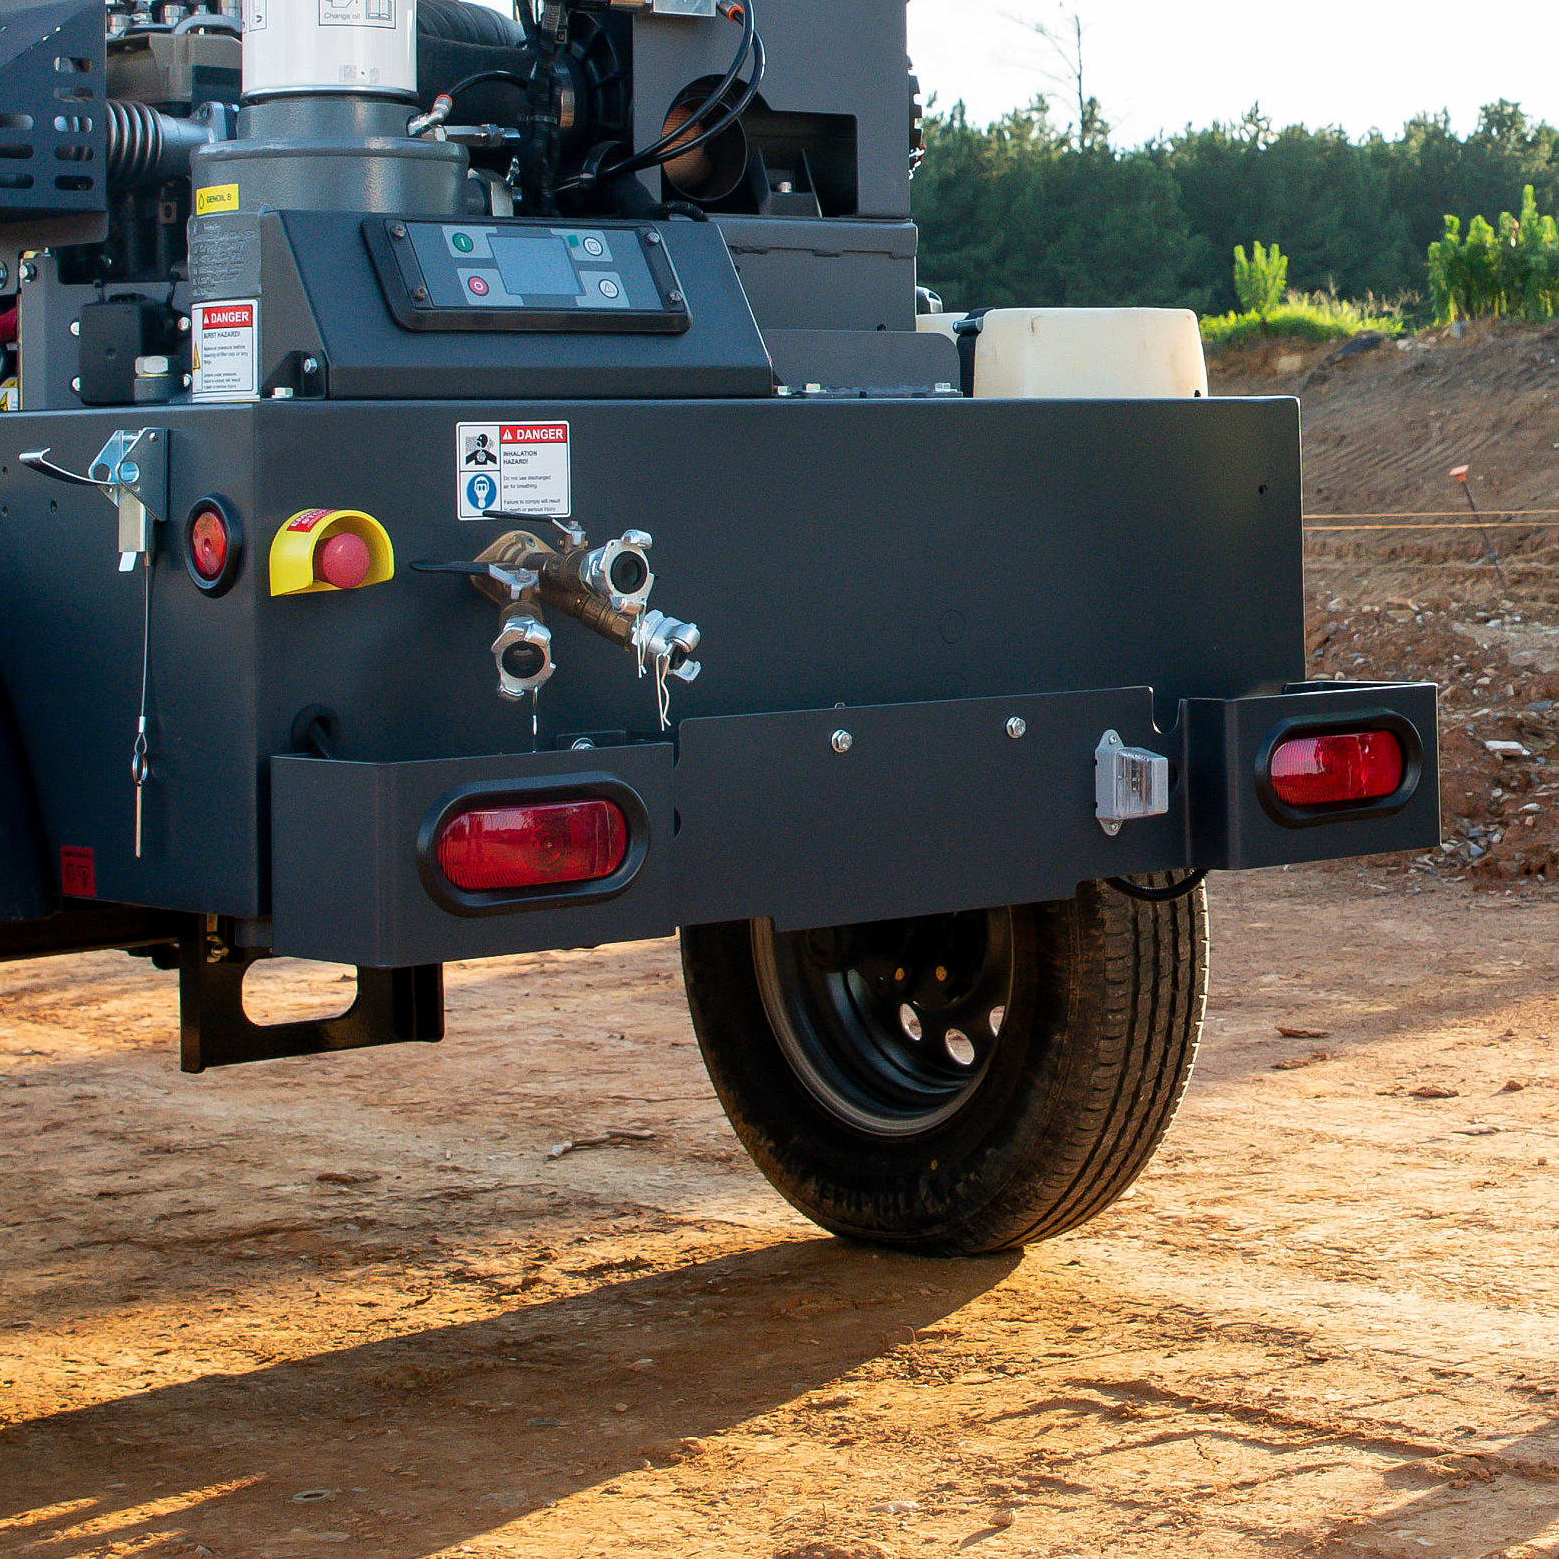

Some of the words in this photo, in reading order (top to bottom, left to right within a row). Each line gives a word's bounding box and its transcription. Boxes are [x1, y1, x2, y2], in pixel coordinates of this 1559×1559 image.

[324, 12, 351, 20] Change
[211, 311, 249, 324] DANGER
[516, 428, 564, 440] DANGER
